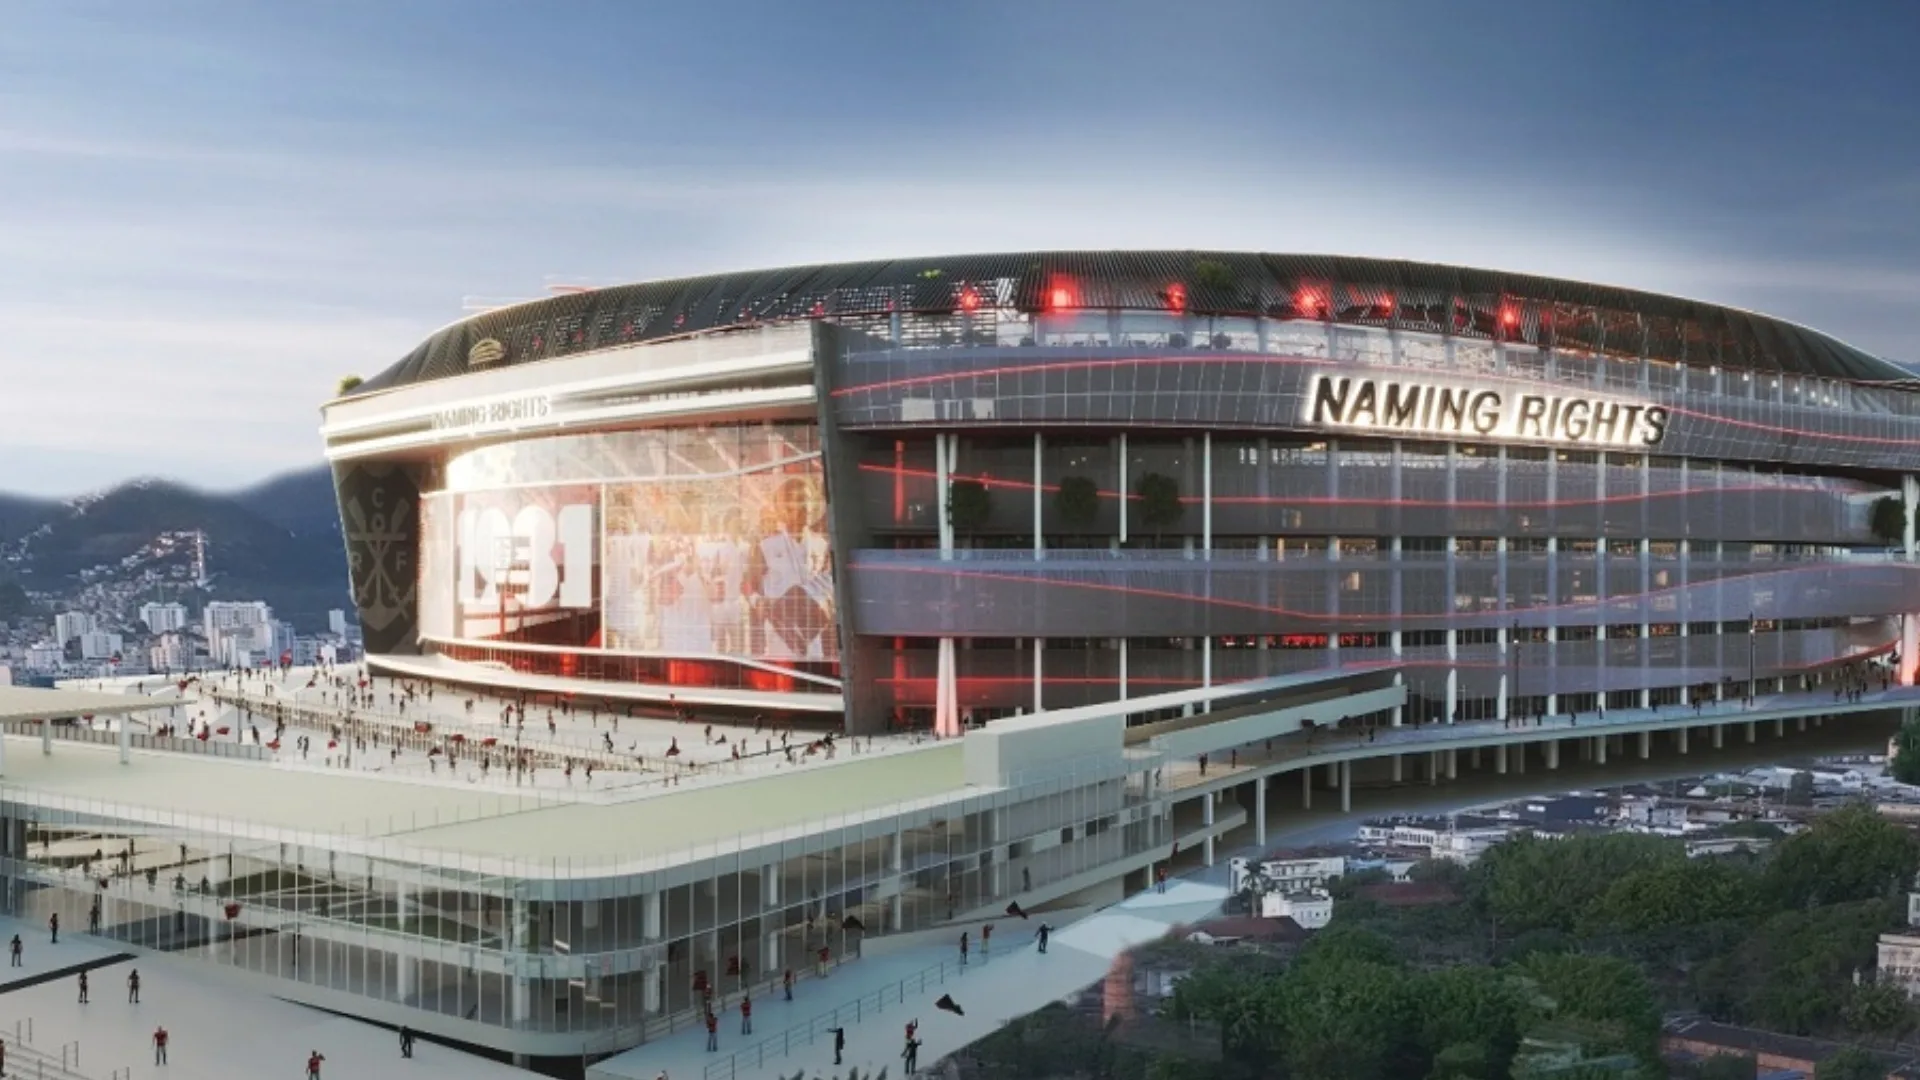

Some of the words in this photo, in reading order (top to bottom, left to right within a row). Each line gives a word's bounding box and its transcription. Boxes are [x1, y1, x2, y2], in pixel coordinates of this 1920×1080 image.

[431, 405, 487, 430] NAMING
[489, 394, 549, 423] RIGHTS
[1312, 377, 1502, 434] NAMING
[1516, 395, 1667, 446] RIGHTS
[371, 487, 386, 509] C
[397, 551, 408, 572] F
